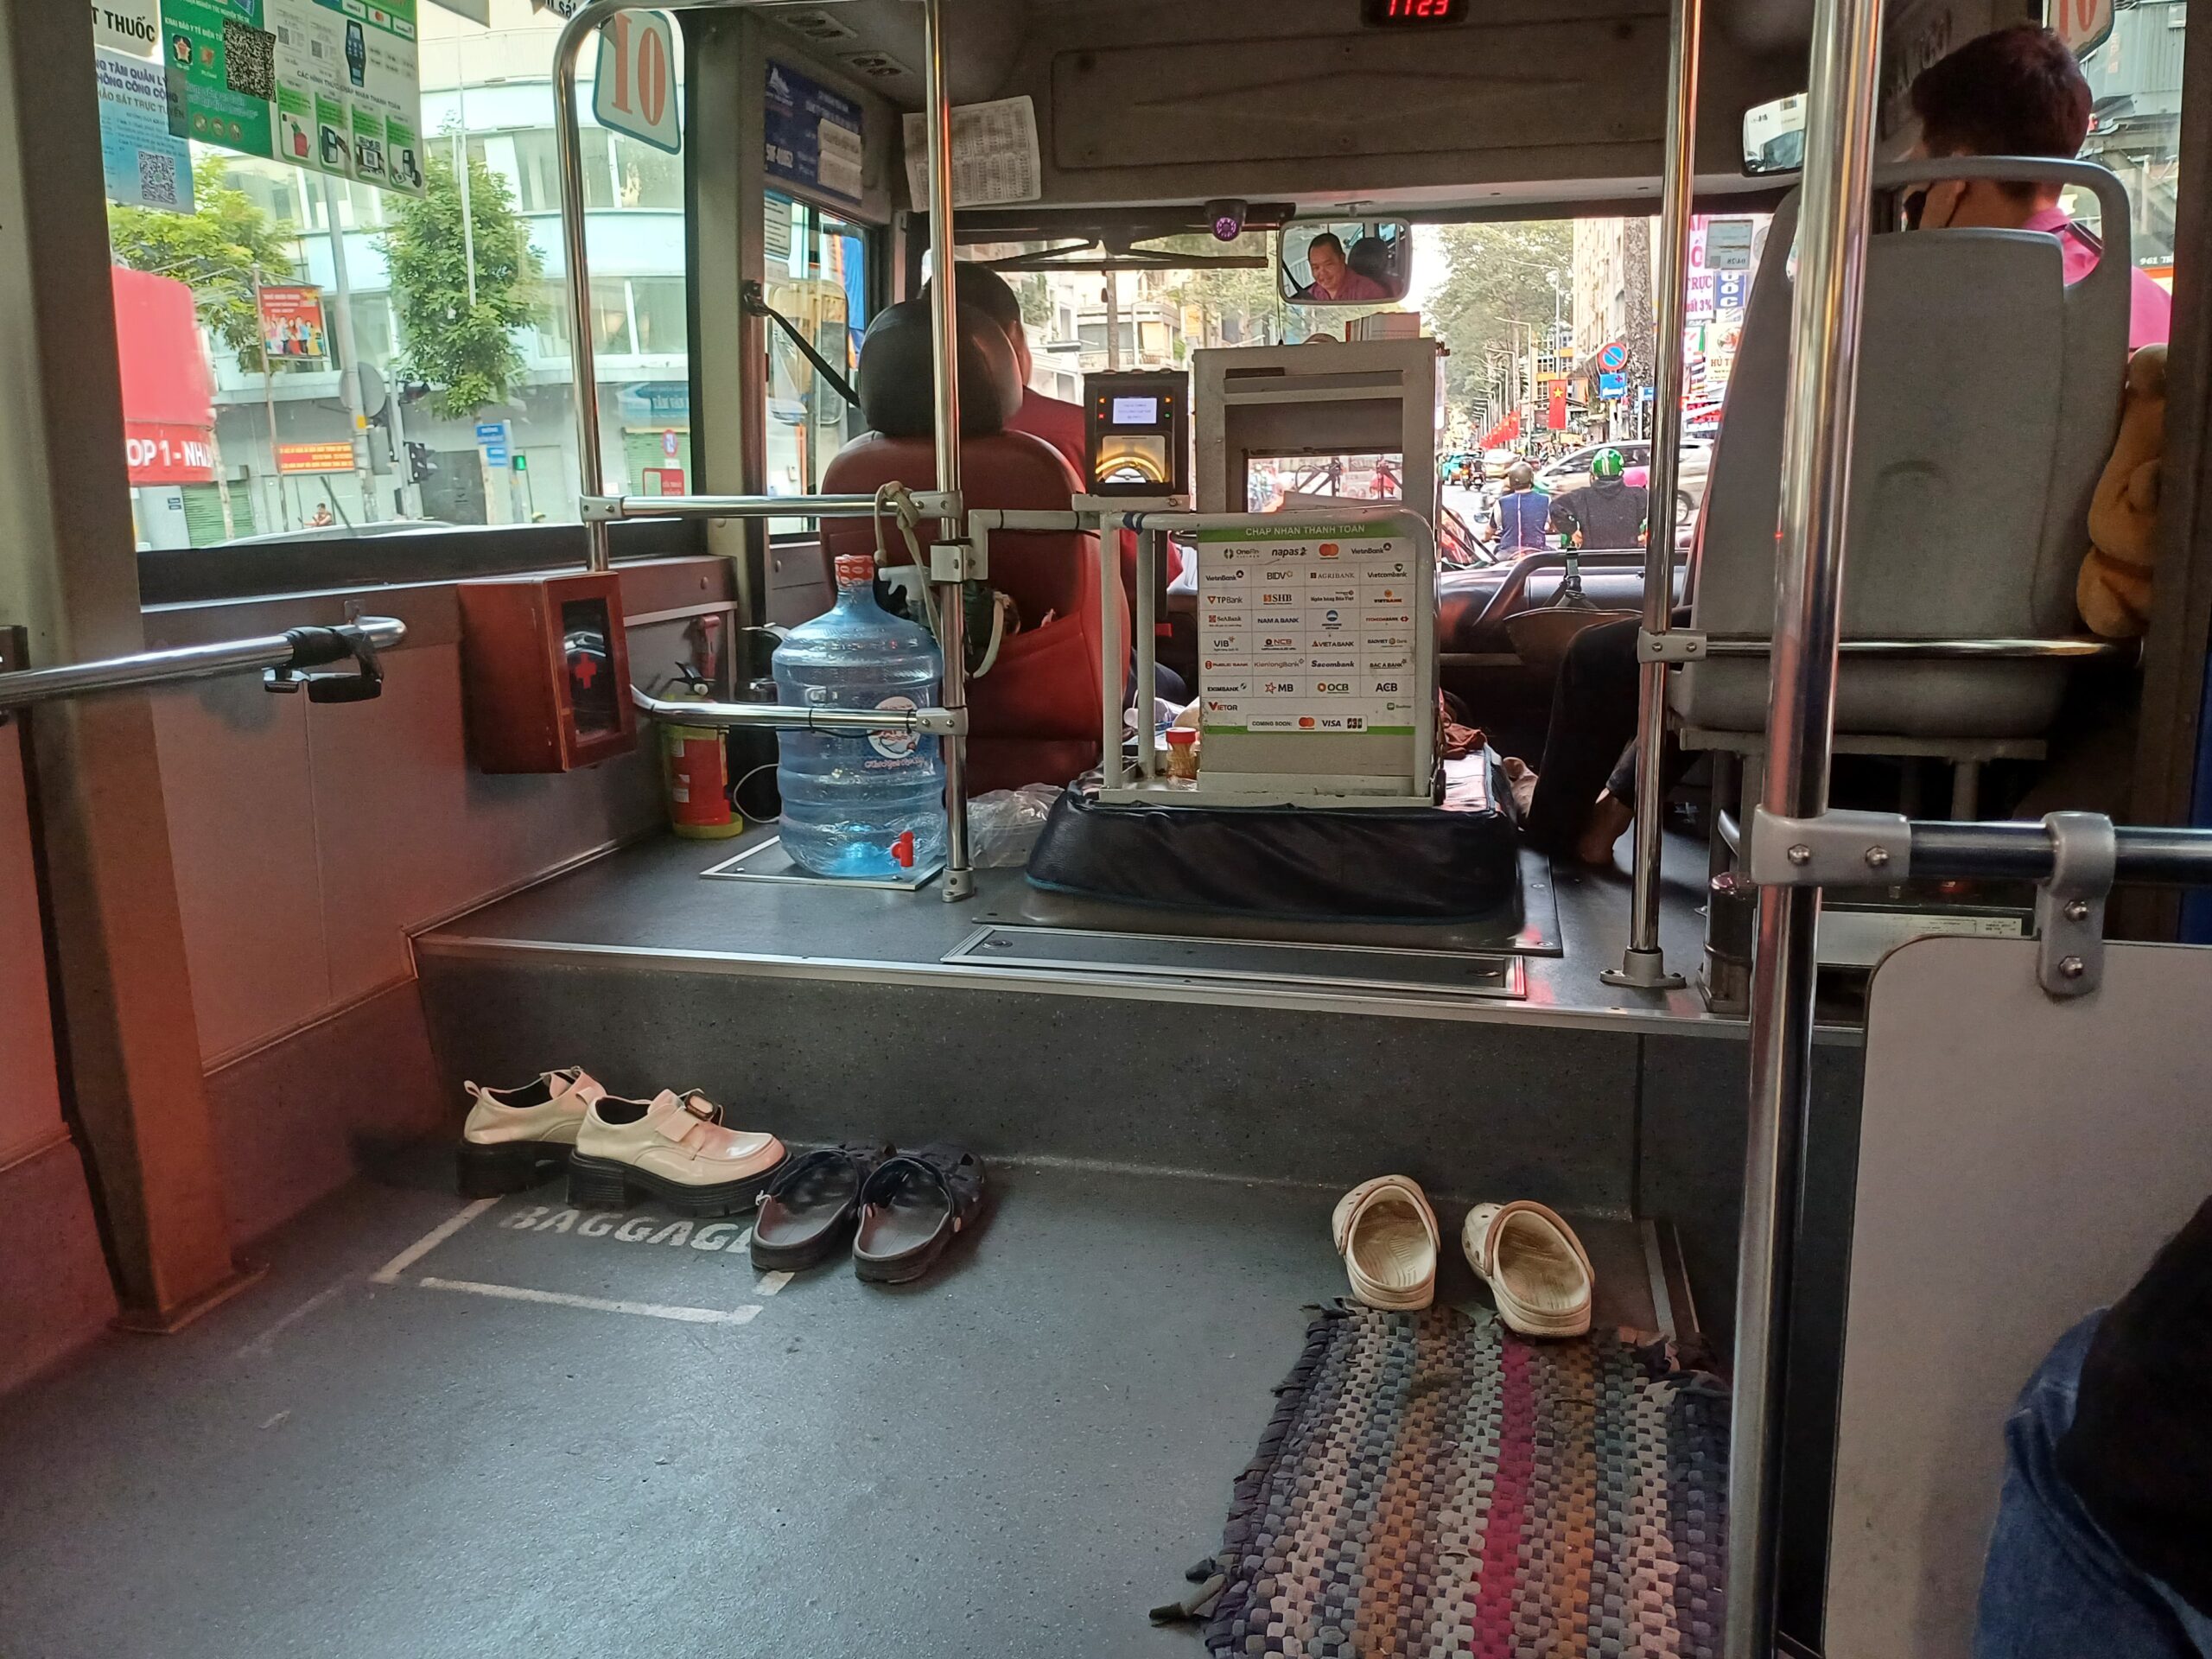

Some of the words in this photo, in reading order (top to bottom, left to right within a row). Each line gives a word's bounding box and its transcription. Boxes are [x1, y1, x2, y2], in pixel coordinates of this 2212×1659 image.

[105, 10, 156, 42] THUỐC
[1304, 525, 1336, 534] THANH
[1272, 549, 1300, 558] napas
[1267, 571, 1287, 580] BIDV
[1272, 594, 1293, 602] SHB
[1311, 659, 1355, 668] Sacombank
[1278, 683, 1294, 692] MB
[1327, 683, 1349, 691] OCB
[1375, 683, 1398, 692] ACB
